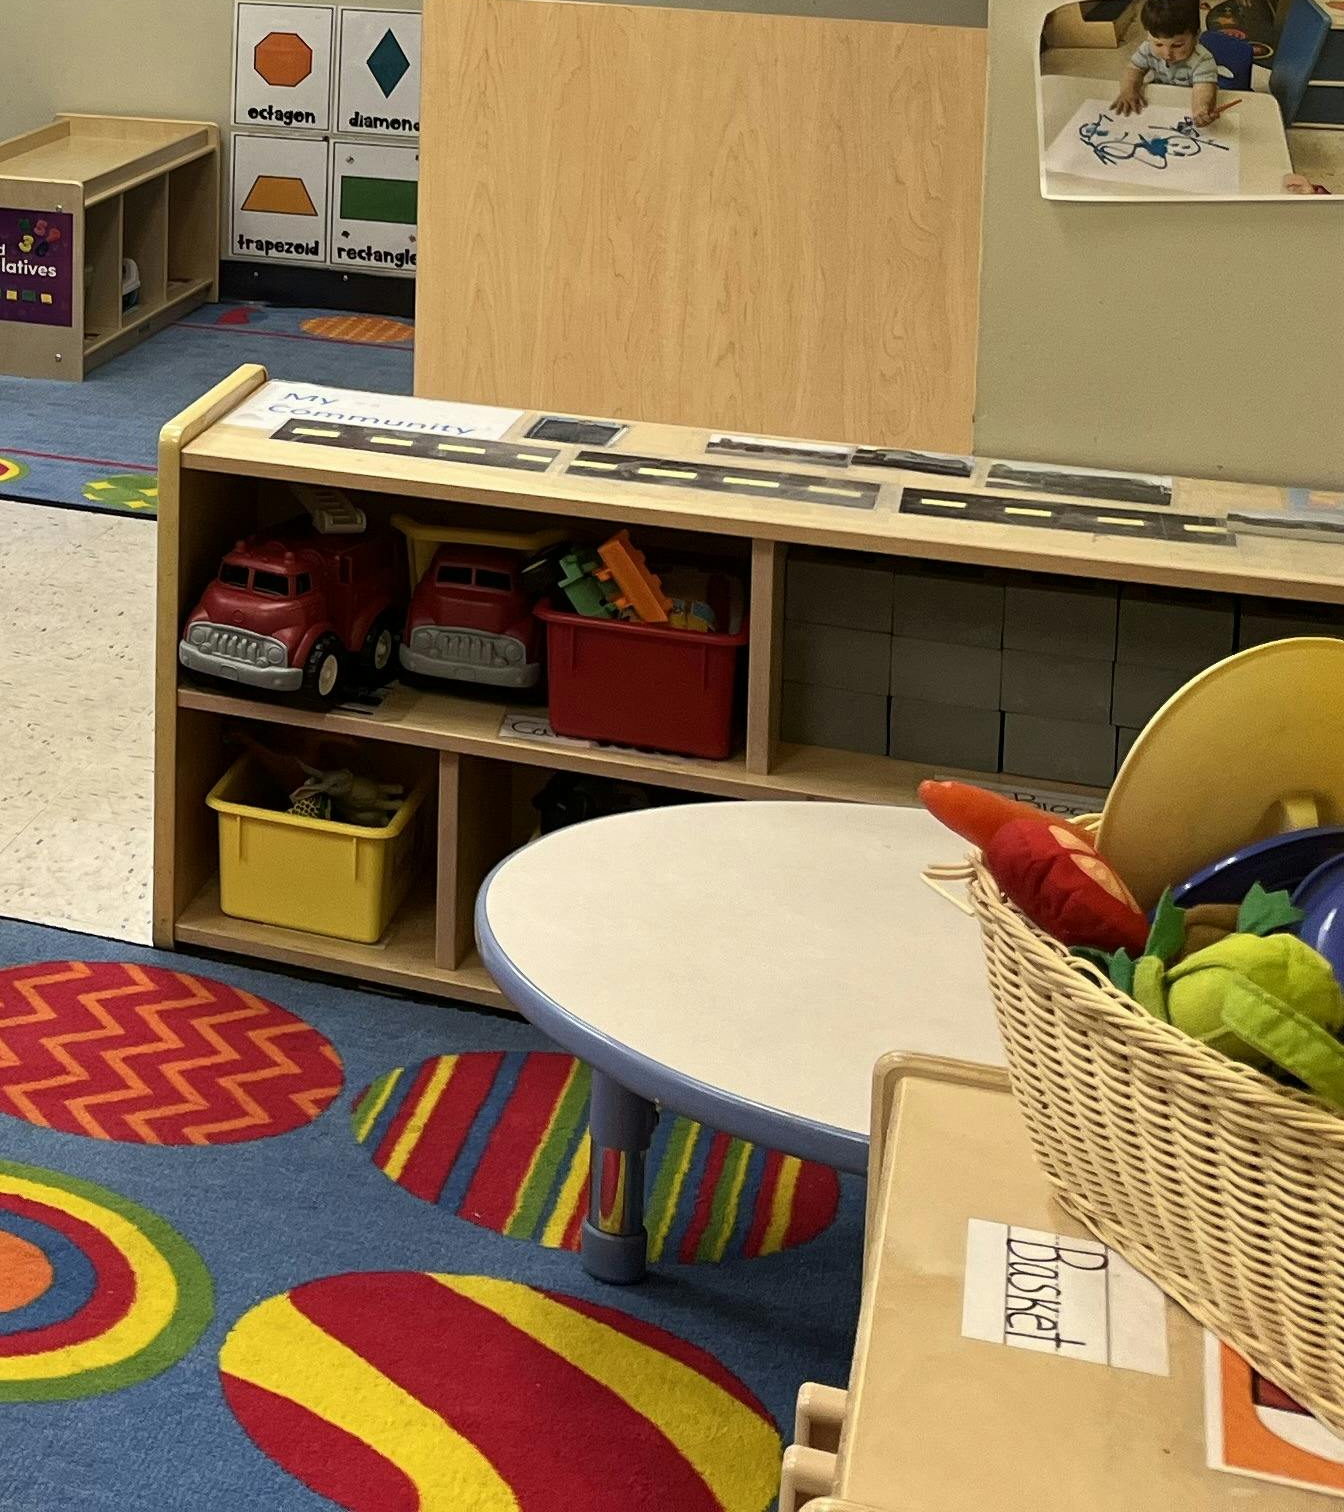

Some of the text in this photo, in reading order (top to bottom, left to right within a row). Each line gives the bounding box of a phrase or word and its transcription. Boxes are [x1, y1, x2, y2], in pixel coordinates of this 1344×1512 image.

[247, 104, 317, 127] octagon
[237, 227, 321, 258] trapezoid
[283, 391, 340, 406] My
[267, 403, 476, 436] Community
[1006, 1237, 1109, 1350] Basket
